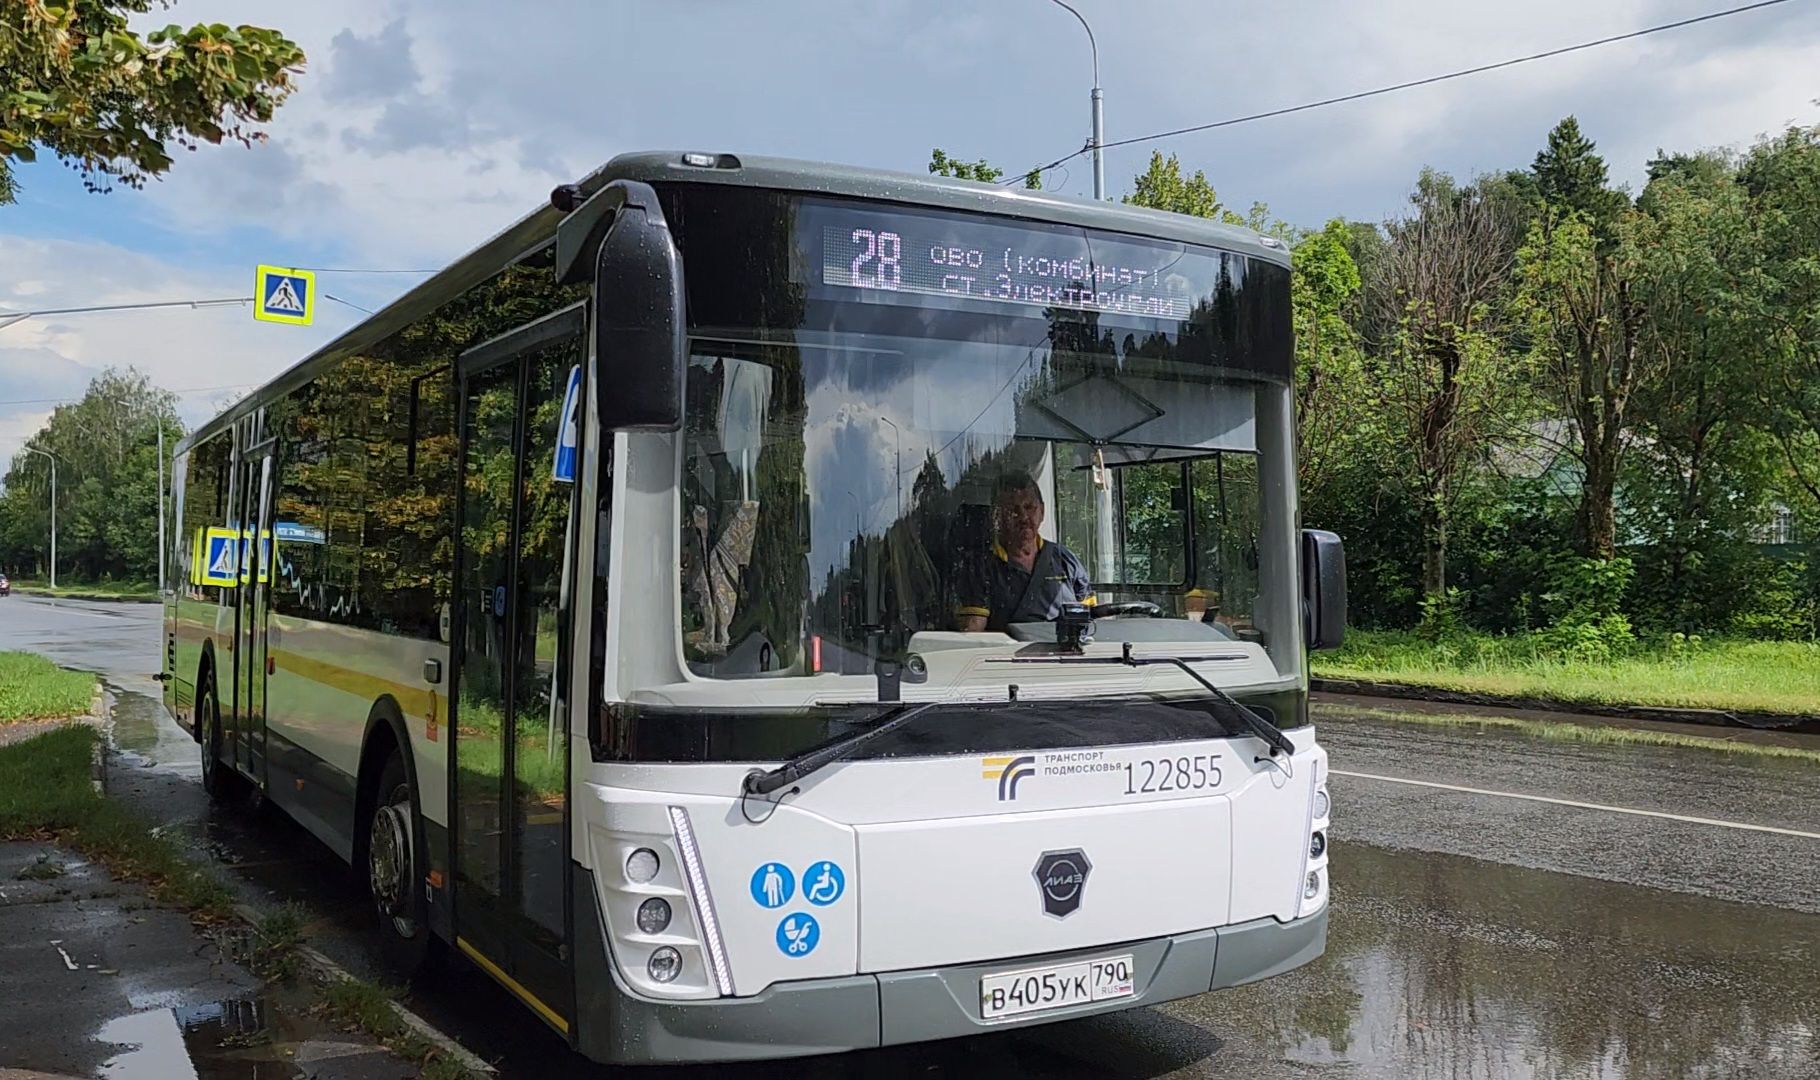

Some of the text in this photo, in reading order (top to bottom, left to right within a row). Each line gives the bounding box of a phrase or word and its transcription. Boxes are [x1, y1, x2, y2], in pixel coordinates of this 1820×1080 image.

[852, 229, 900, 291] 28
[1045, 752, 1104, 763] ТРАНСПОРТ
[1044, 763, 1122, 776] ПОДМОСКОВЬЯ
[1123, 755, 1222, 795] 122855
[1043, 873, 1083, 887] ЛИАЗ
[1093, 961, 1129, 987] 790
[1101, 985, 1119, 995] RUS
